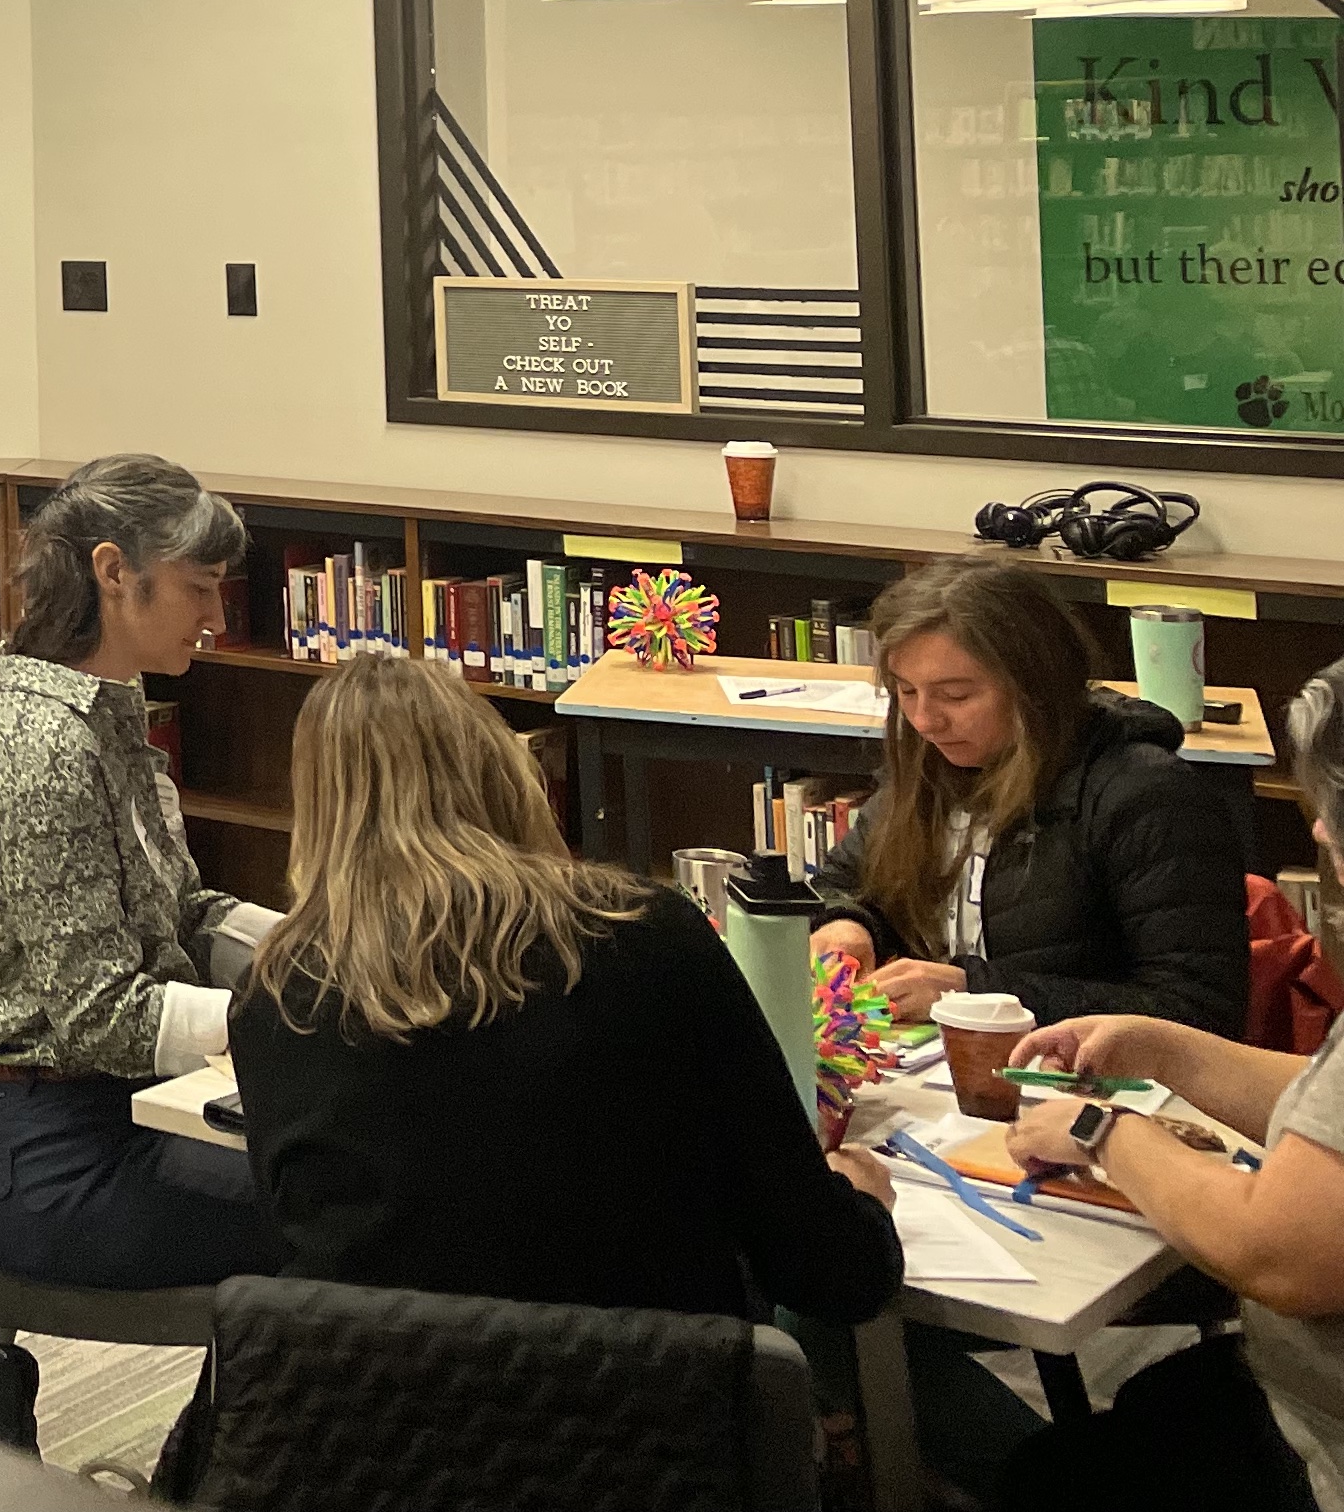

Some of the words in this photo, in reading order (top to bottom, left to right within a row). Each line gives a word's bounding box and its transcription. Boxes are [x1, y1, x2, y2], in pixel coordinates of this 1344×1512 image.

[1076, 53, 1281, 128] Kind
[1082, 242, 1163, 285] but
[1179, 243, 1292, 287] their
[525, 294, 591, 311] TREAT
[545, 315, 572, 331] YO
[502, 355, 566, 373] CHECK
[572, 358, 614, 375] OUT
[494, 375, 509, 391] A
[520, 376, 564, 394] NEW
[577, 379, 629, 398] BOOK
